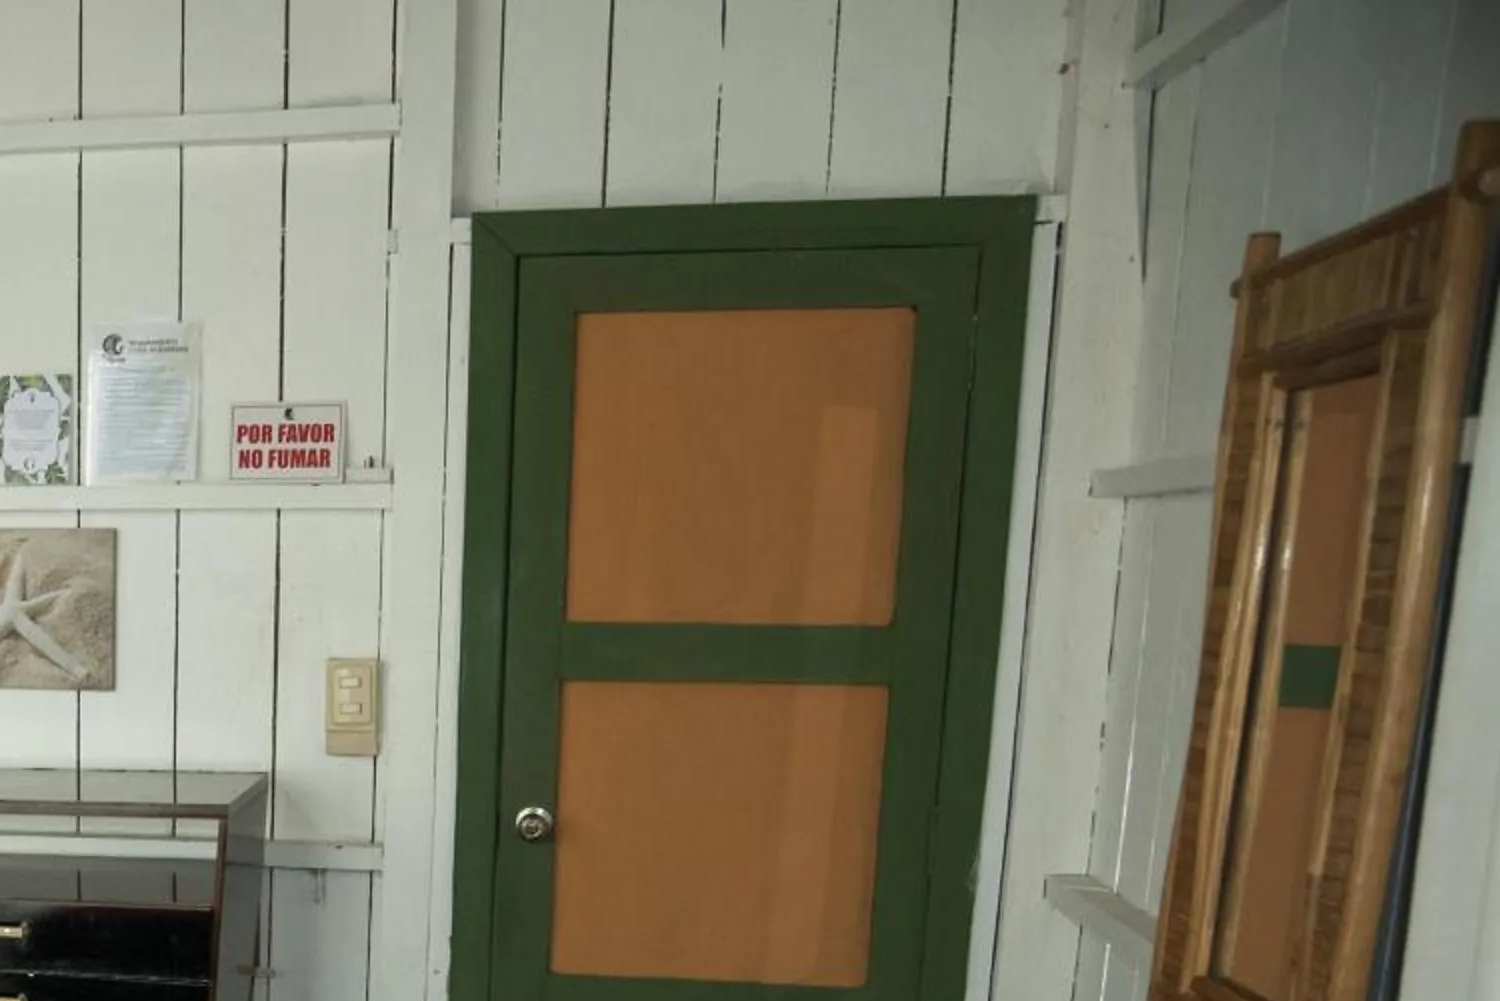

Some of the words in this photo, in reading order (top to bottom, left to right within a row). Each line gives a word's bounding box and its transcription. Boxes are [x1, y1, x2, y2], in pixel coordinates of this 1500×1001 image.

[236, 423, 273, 444] POR
[277, 423, 335, 443] FAVOR
[238, 448, 263, 469] NO
[267, 447, 331, 469] FUMAR
